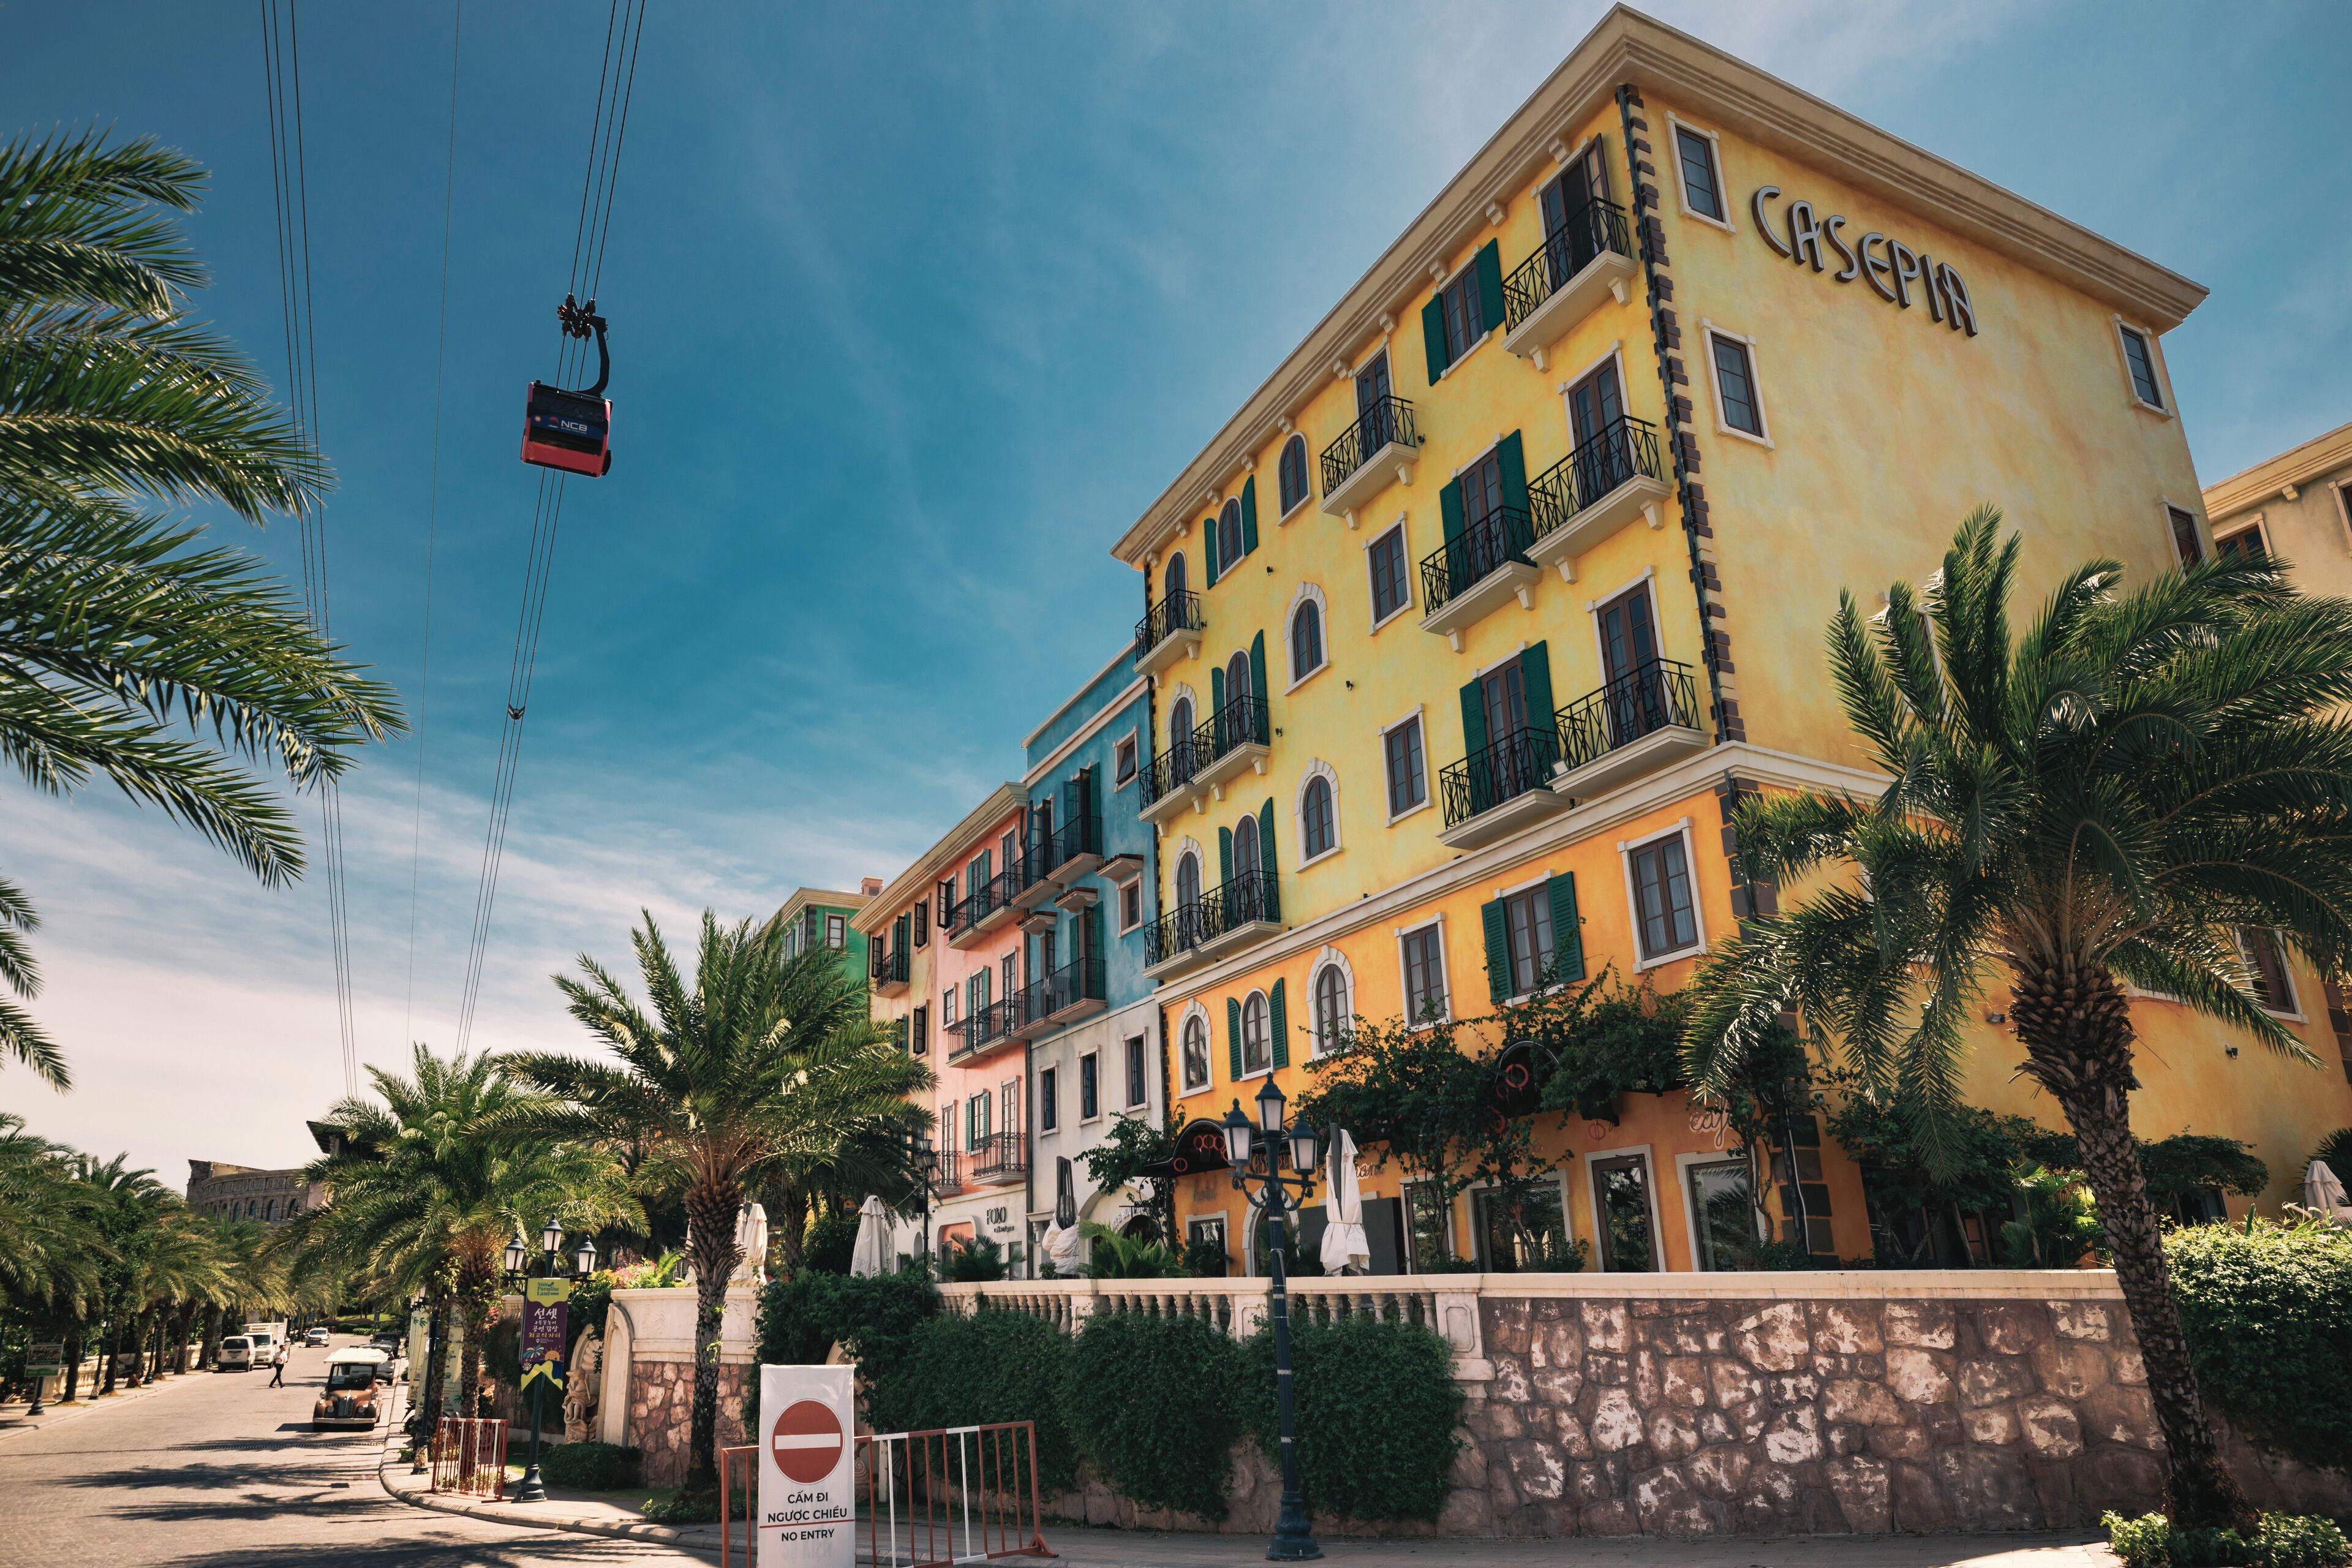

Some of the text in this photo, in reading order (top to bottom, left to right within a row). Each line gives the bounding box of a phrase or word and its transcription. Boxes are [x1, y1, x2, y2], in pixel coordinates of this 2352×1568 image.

[1752, 186, 1978, 337] CASEPIA
[561, 420, 587, 432] NCB
[787, 1490, 828, 1504] CẤM ĐI
[767, 1505, 848, 1523] NGƯỢC CHIỀU
[781, 1528, 835, 1542] NO ENTRY
